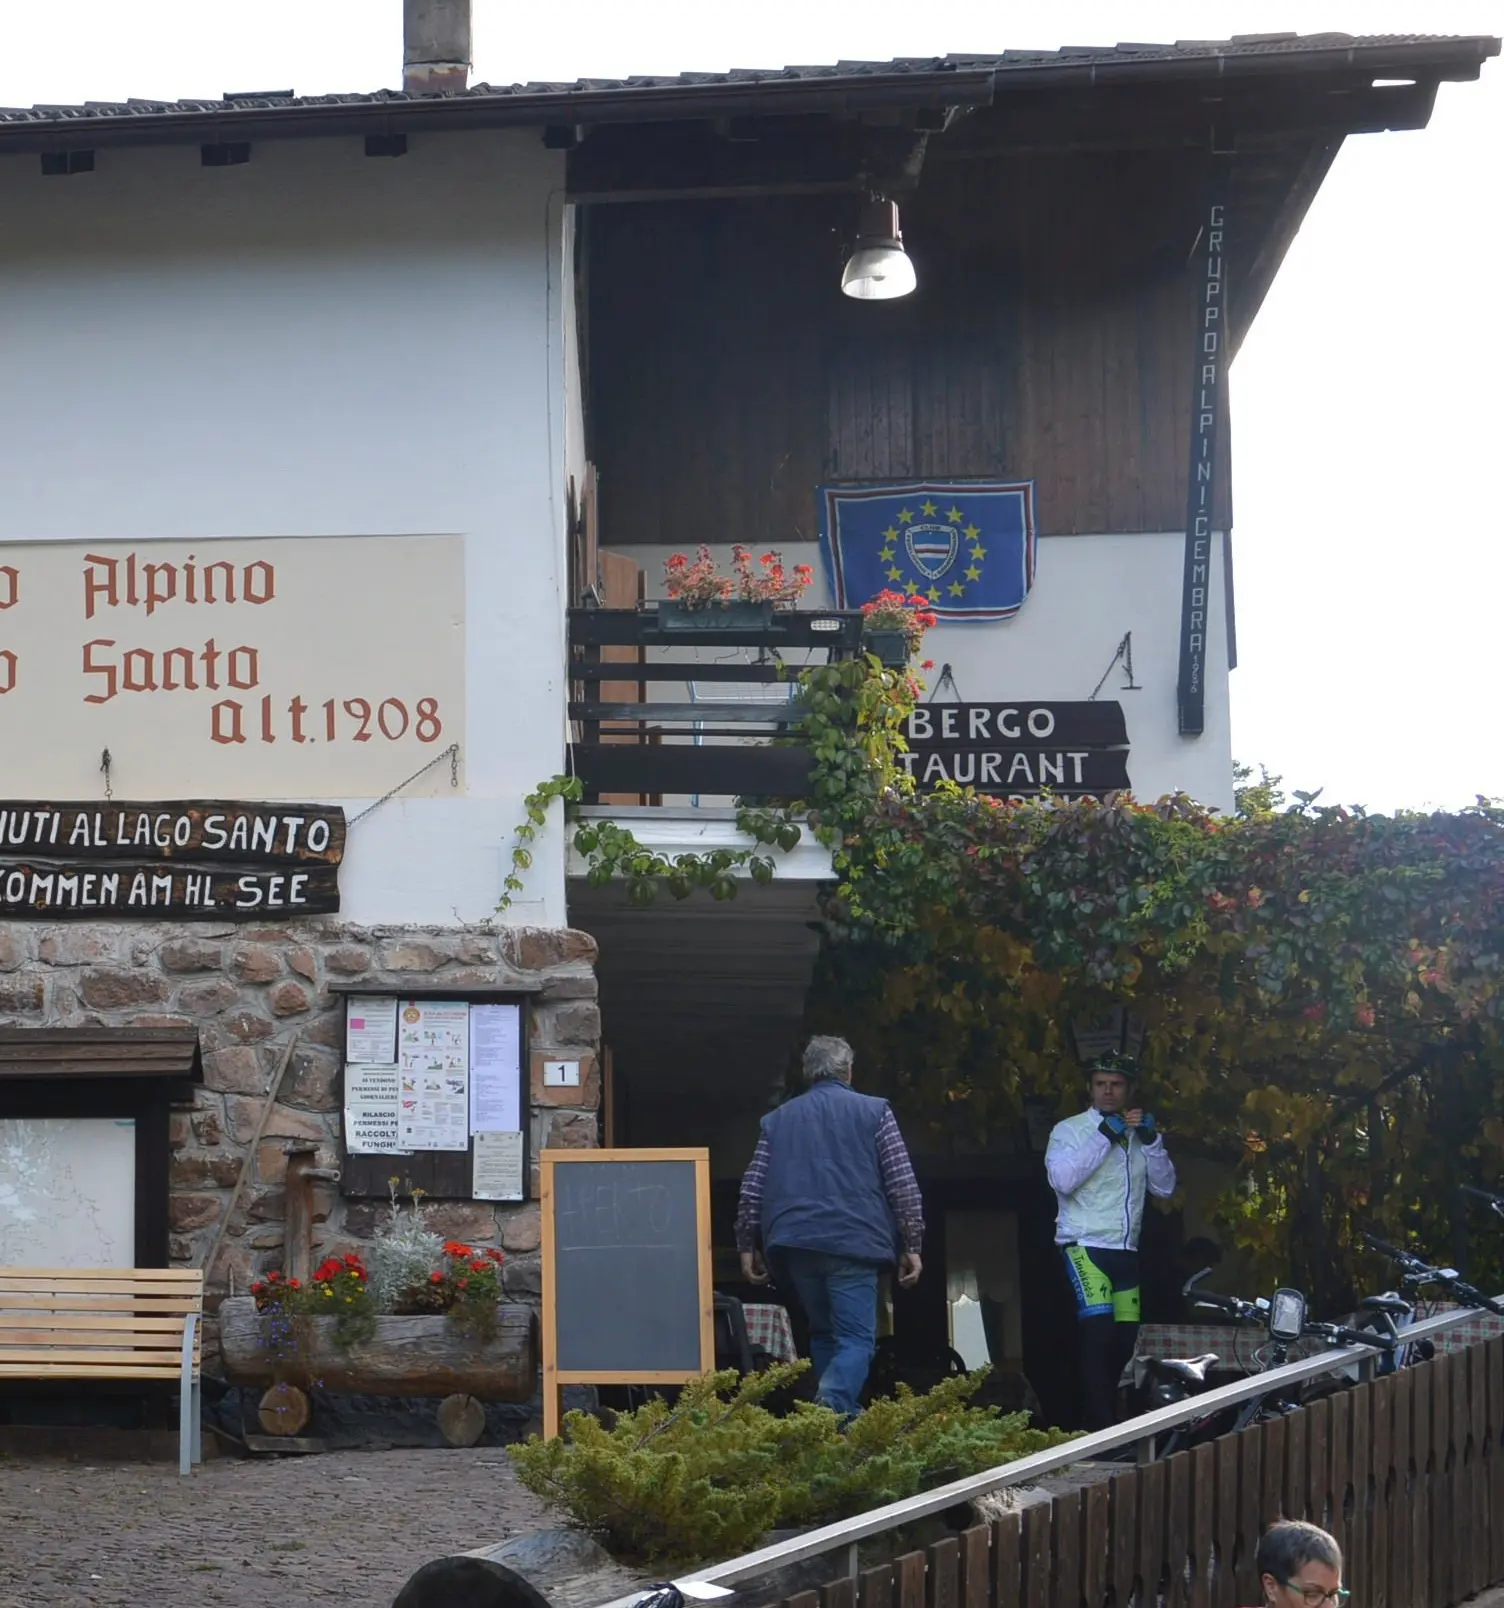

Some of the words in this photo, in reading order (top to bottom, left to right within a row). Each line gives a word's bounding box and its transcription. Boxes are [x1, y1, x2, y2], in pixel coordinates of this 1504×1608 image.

[83, 552, 276, 619] Alpino
[82, 637, 260, 704] Santo
[907, 708, 1056, 739] BERGO
[897, 752, 1090, 784] TAURANT
[69, 812, 108, 847] AL
[116, 812, 192, 847] LAGO
[201, 815, 330, 854] SANTO
[128, 872, 173, 906] AM
[236, 874, 309, 908] SEE
[557, 1064, 566, 1083] 1
